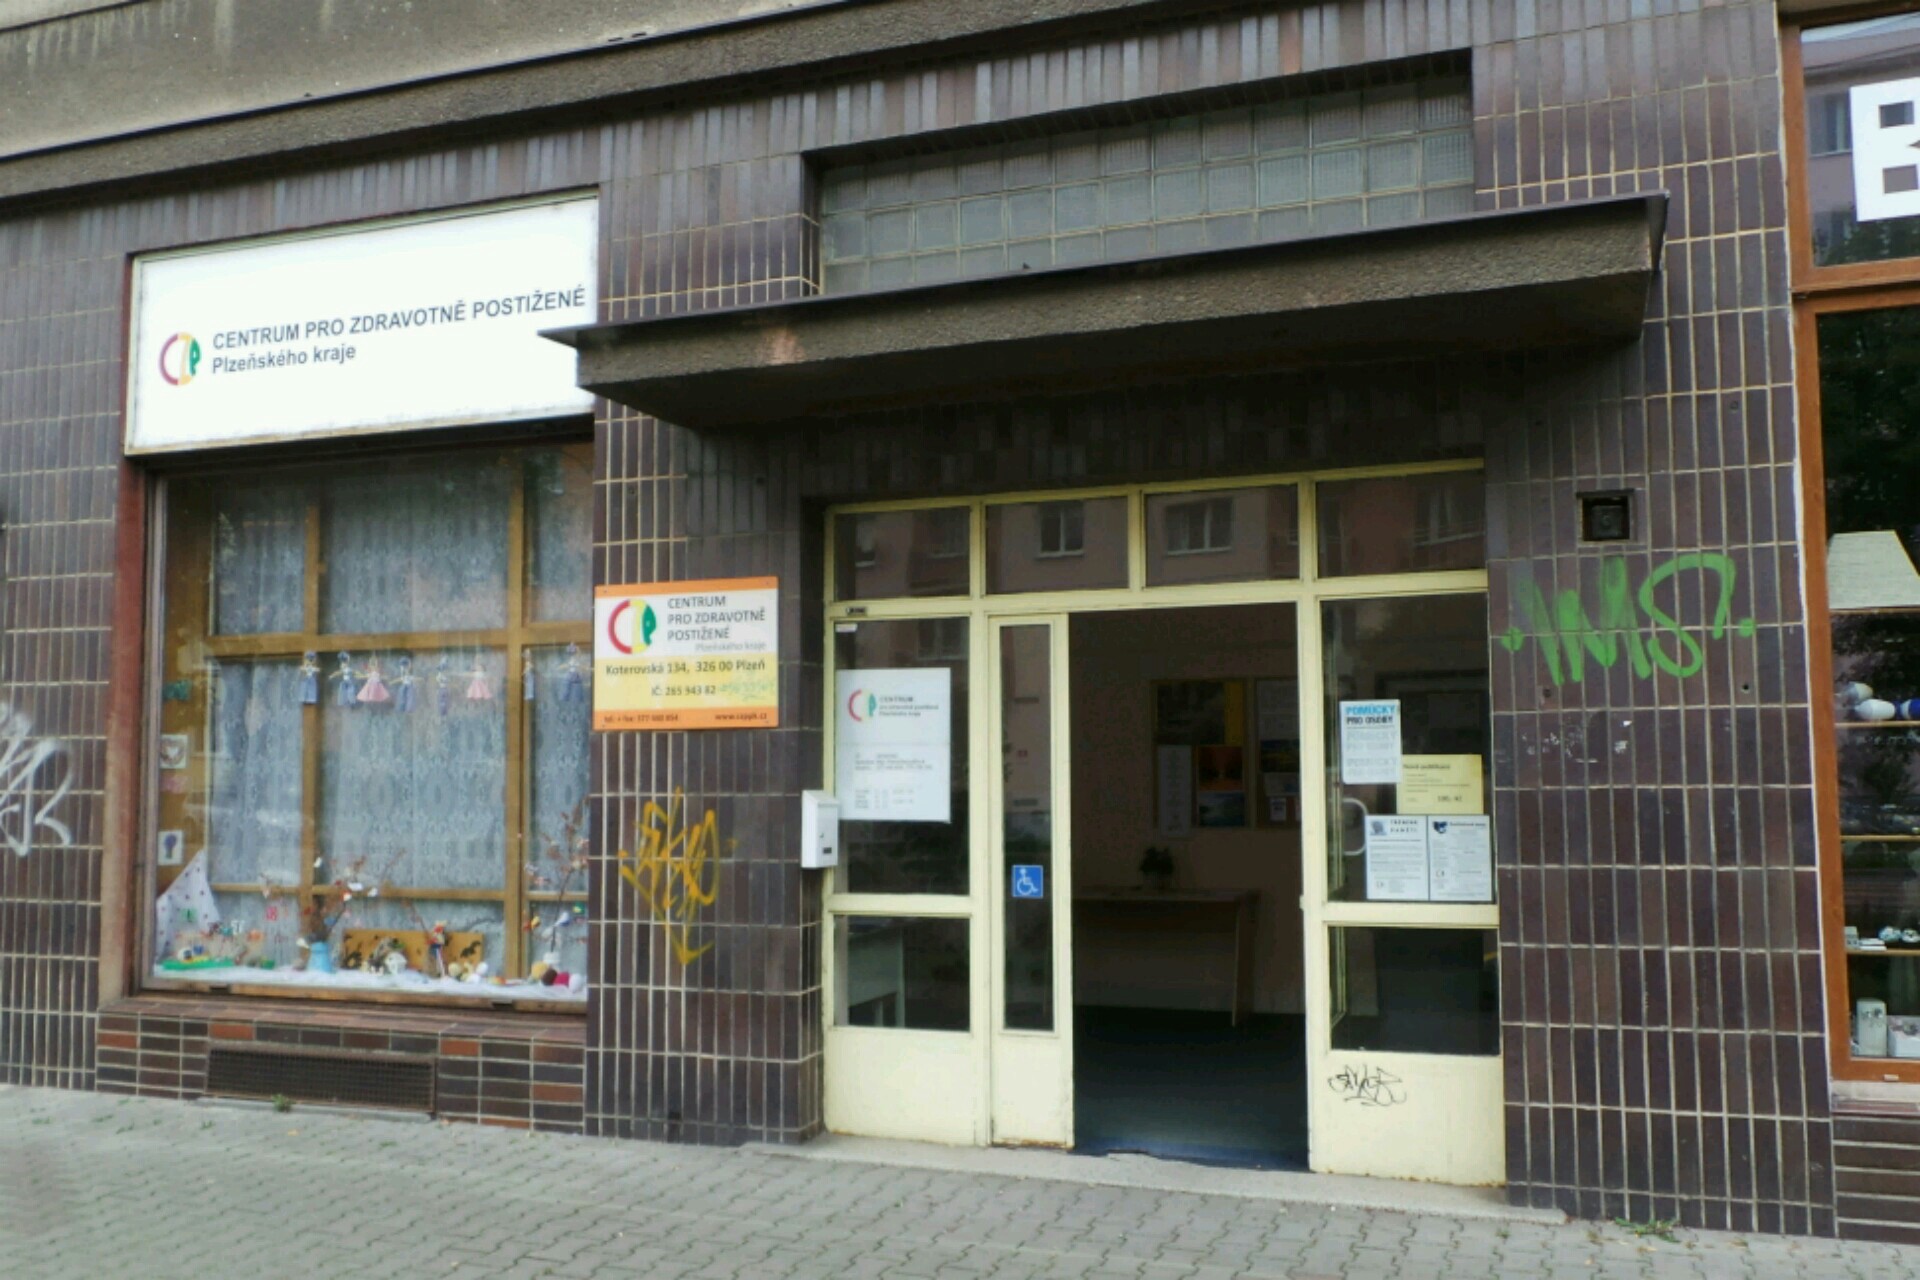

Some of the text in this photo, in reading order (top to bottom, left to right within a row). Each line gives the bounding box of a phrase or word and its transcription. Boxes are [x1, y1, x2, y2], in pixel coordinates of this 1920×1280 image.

[213, 284, 587, 350] CENTRUM PRO ZDRAVOTNĚ POSTIŽENÉ
[212, 343, 357, 374] Plzeňského kraje
[667, 596, 726, 610] CENTRUM
[667, 607, 766, 625] PRO ZDRAVOTNĚ
[667, 626, 730, 641] POSTIŽENÉ
